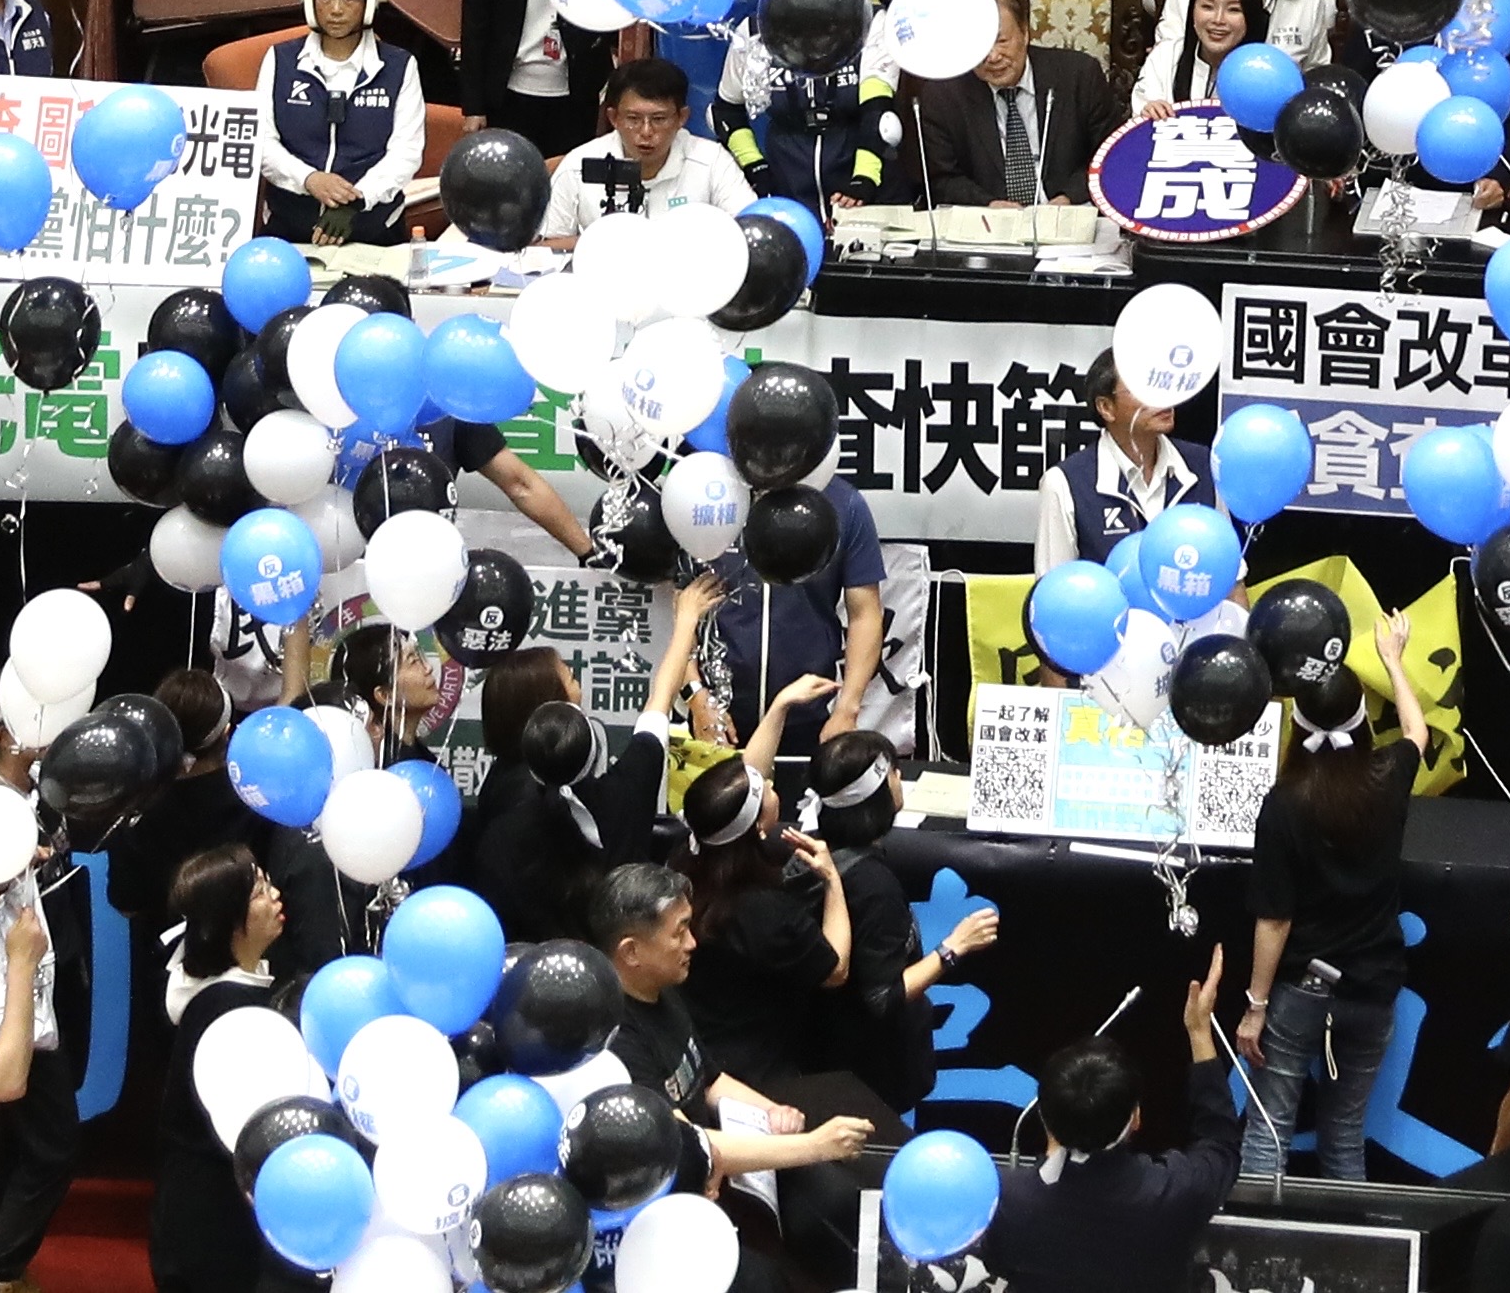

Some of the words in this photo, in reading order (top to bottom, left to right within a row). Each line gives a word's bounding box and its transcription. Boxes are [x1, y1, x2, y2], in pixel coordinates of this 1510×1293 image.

[1169, 345, 1194, 368] 反
[1146, 369, 1203, 393] 擴權
[692, 501, 738, 527] 擴權
[258, 554, 282, 578] 反
[1173, 543, 1200, 570] 反
[250, 569, 307, 606] 黑箱
[1157, 564, 1213, 598] 黑箱
[480, 606, 505, 629] 反
[461, 626, 512, 652] 惡法
[1323, 637, 1344, 661] 反
[982, 704, 1051, 723] 一起了解
[979, 724, 1049, 744] 國會改革
